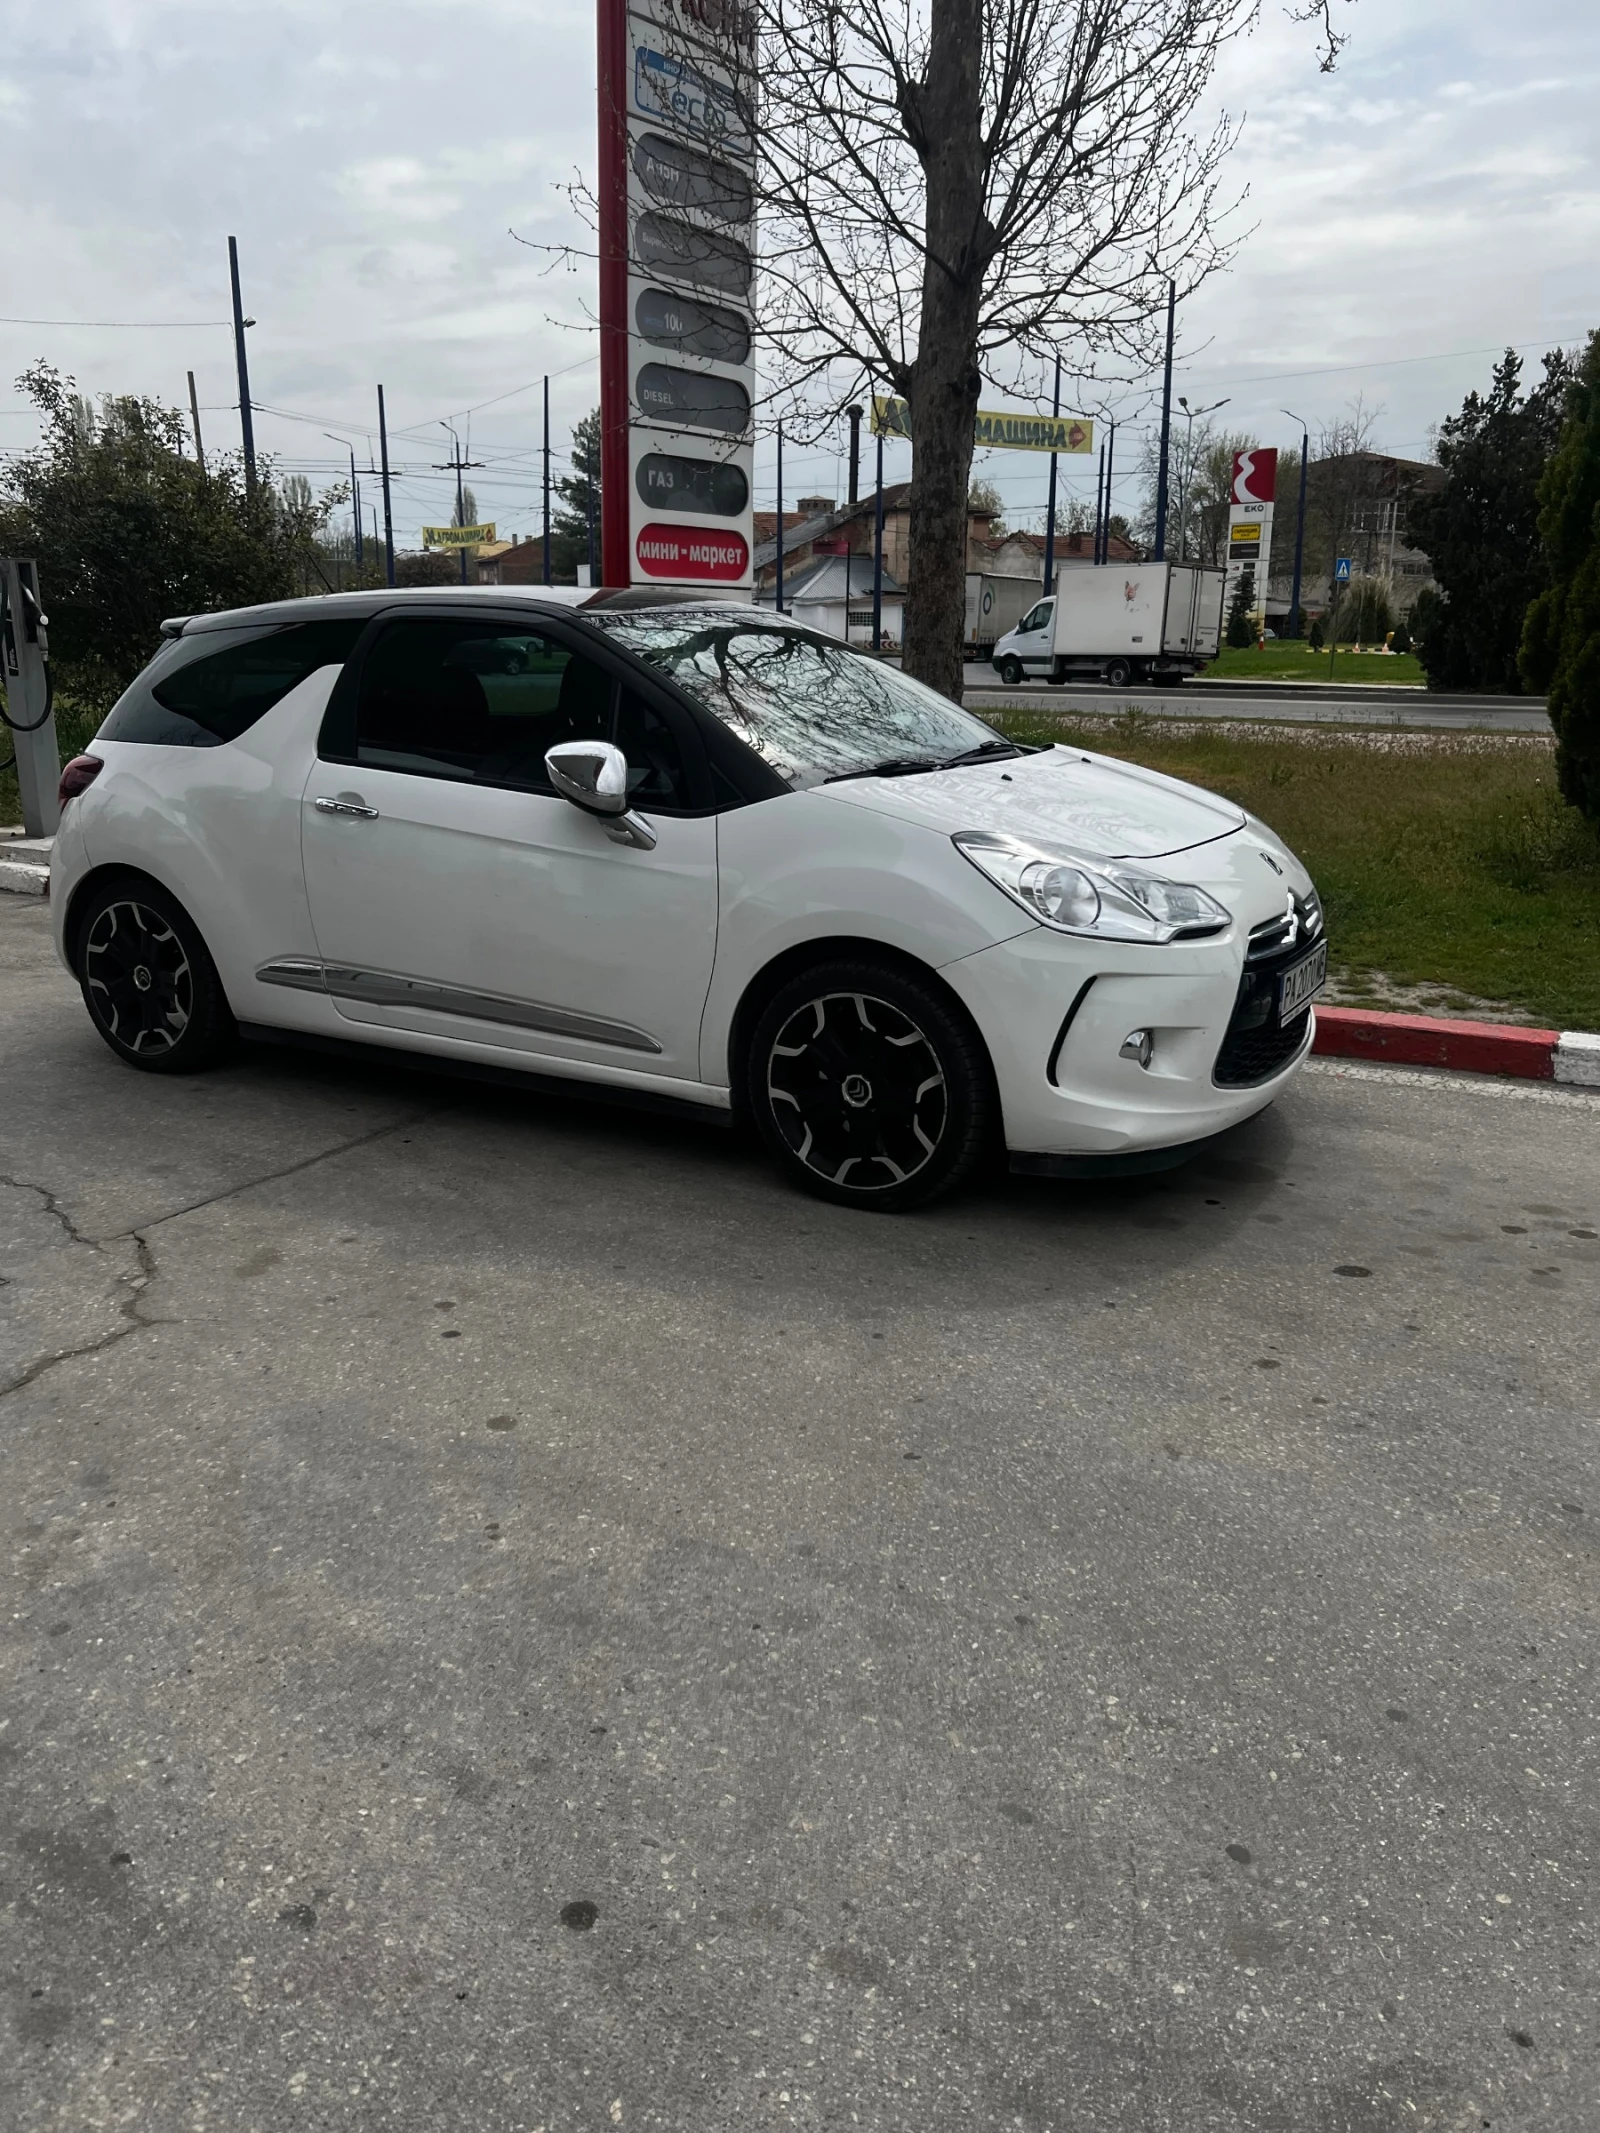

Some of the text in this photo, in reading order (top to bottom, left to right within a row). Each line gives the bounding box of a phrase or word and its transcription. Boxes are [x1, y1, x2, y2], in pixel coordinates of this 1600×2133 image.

[643, 389, 674, 405] DIESEL
[976, 416, 1067, 447] МАШИНА
[648, 470, 674, 488] ГАЗ
